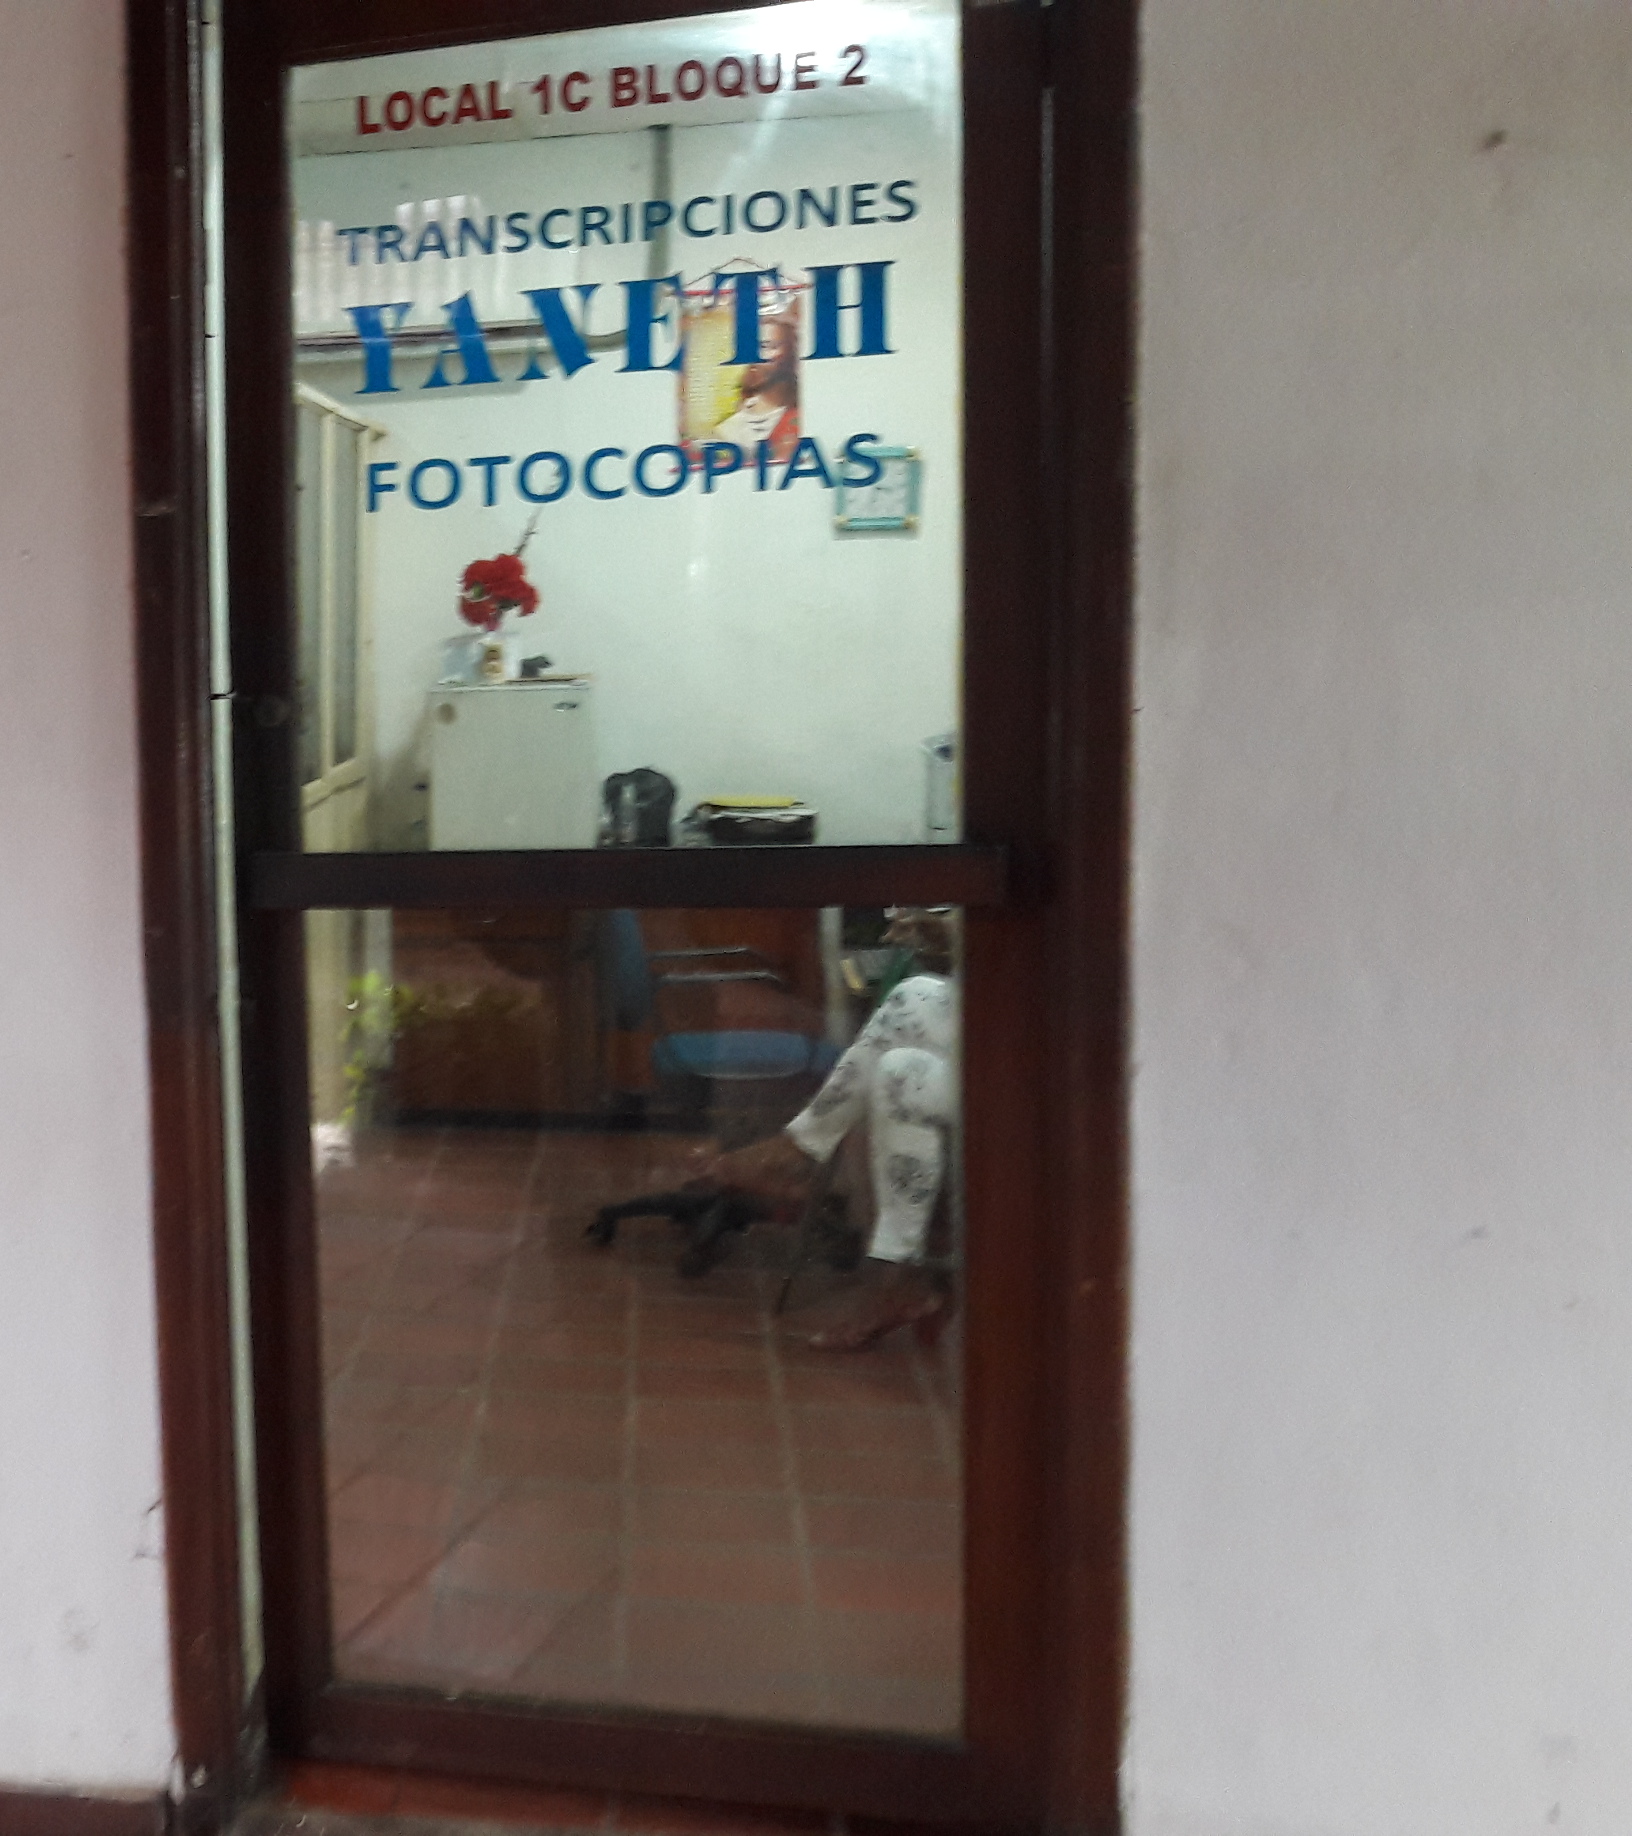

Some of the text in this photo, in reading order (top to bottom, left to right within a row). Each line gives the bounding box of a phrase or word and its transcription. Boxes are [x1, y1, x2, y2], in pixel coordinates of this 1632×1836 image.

[358, 45, 866, 135] LOCAL 1C BLOQUE 2
[339, 180, 917, 265] TRANSCRIPCIONES
[344, 260, 896, 395] YANETH
[366, 433, 884, 512] FOTOCOPIAS
